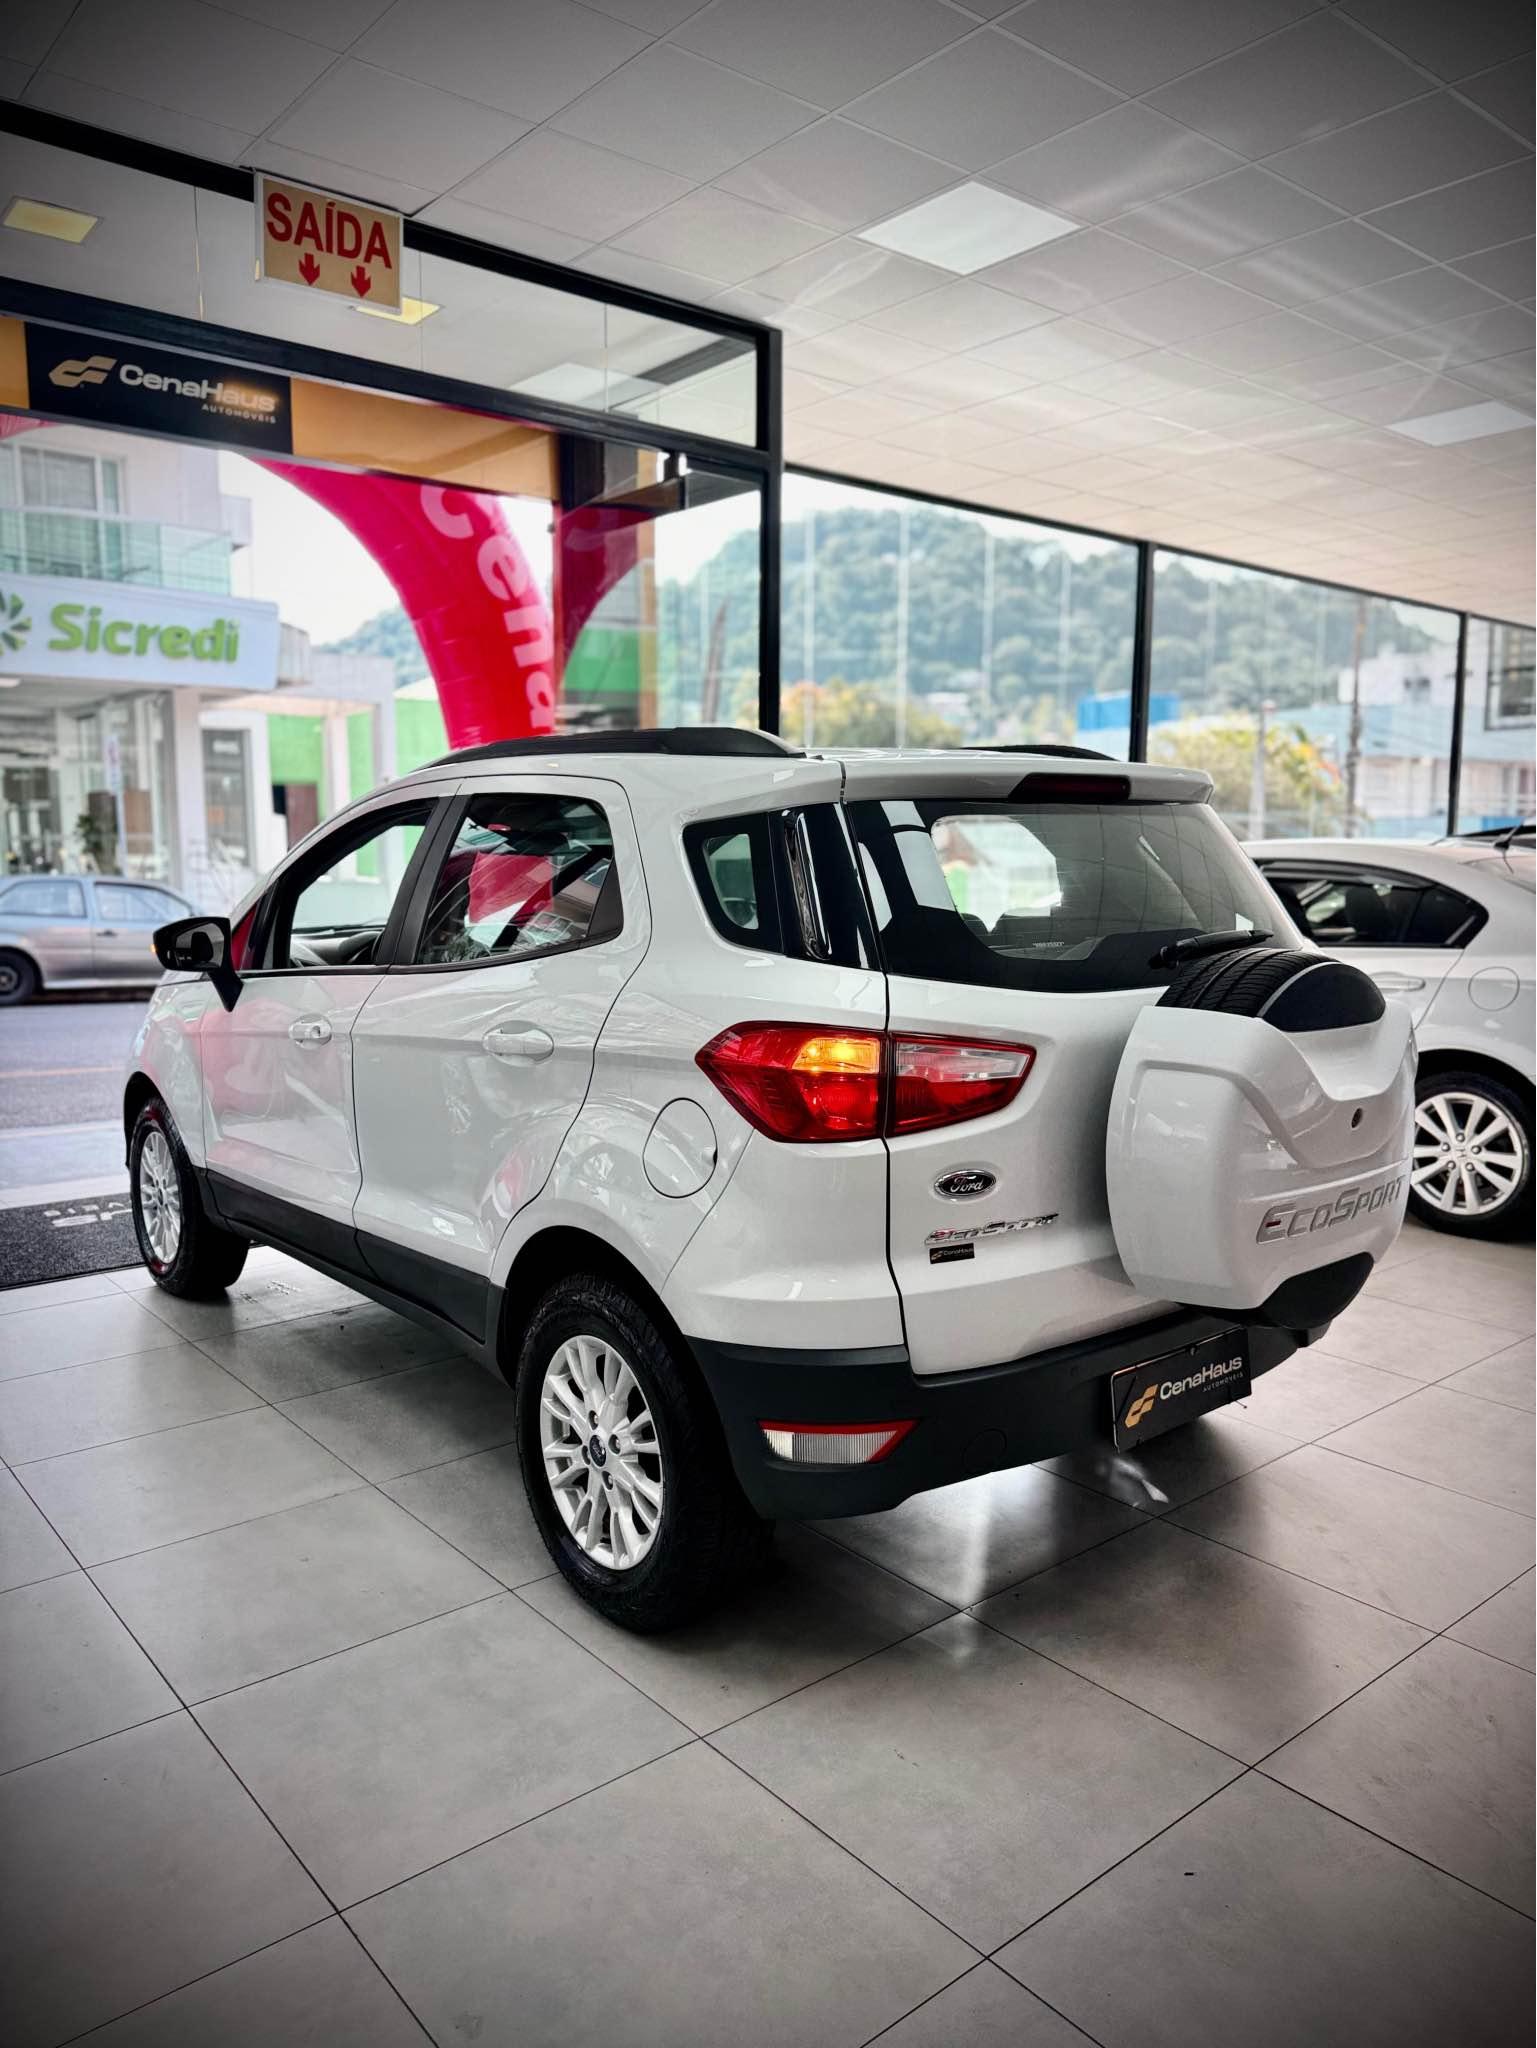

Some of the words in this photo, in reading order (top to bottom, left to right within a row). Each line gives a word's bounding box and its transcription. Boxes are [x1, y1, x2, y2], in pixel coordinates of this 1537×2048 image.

[266, 192, 392, 269] SAÍDA
[119, 364, 276, 412] CenaHaus
[48, 603, 240, 664] Sicredi
[950, 1174, 984, 1193] Ford
[1160, 1356, 1243, 1400] CenaHaus
